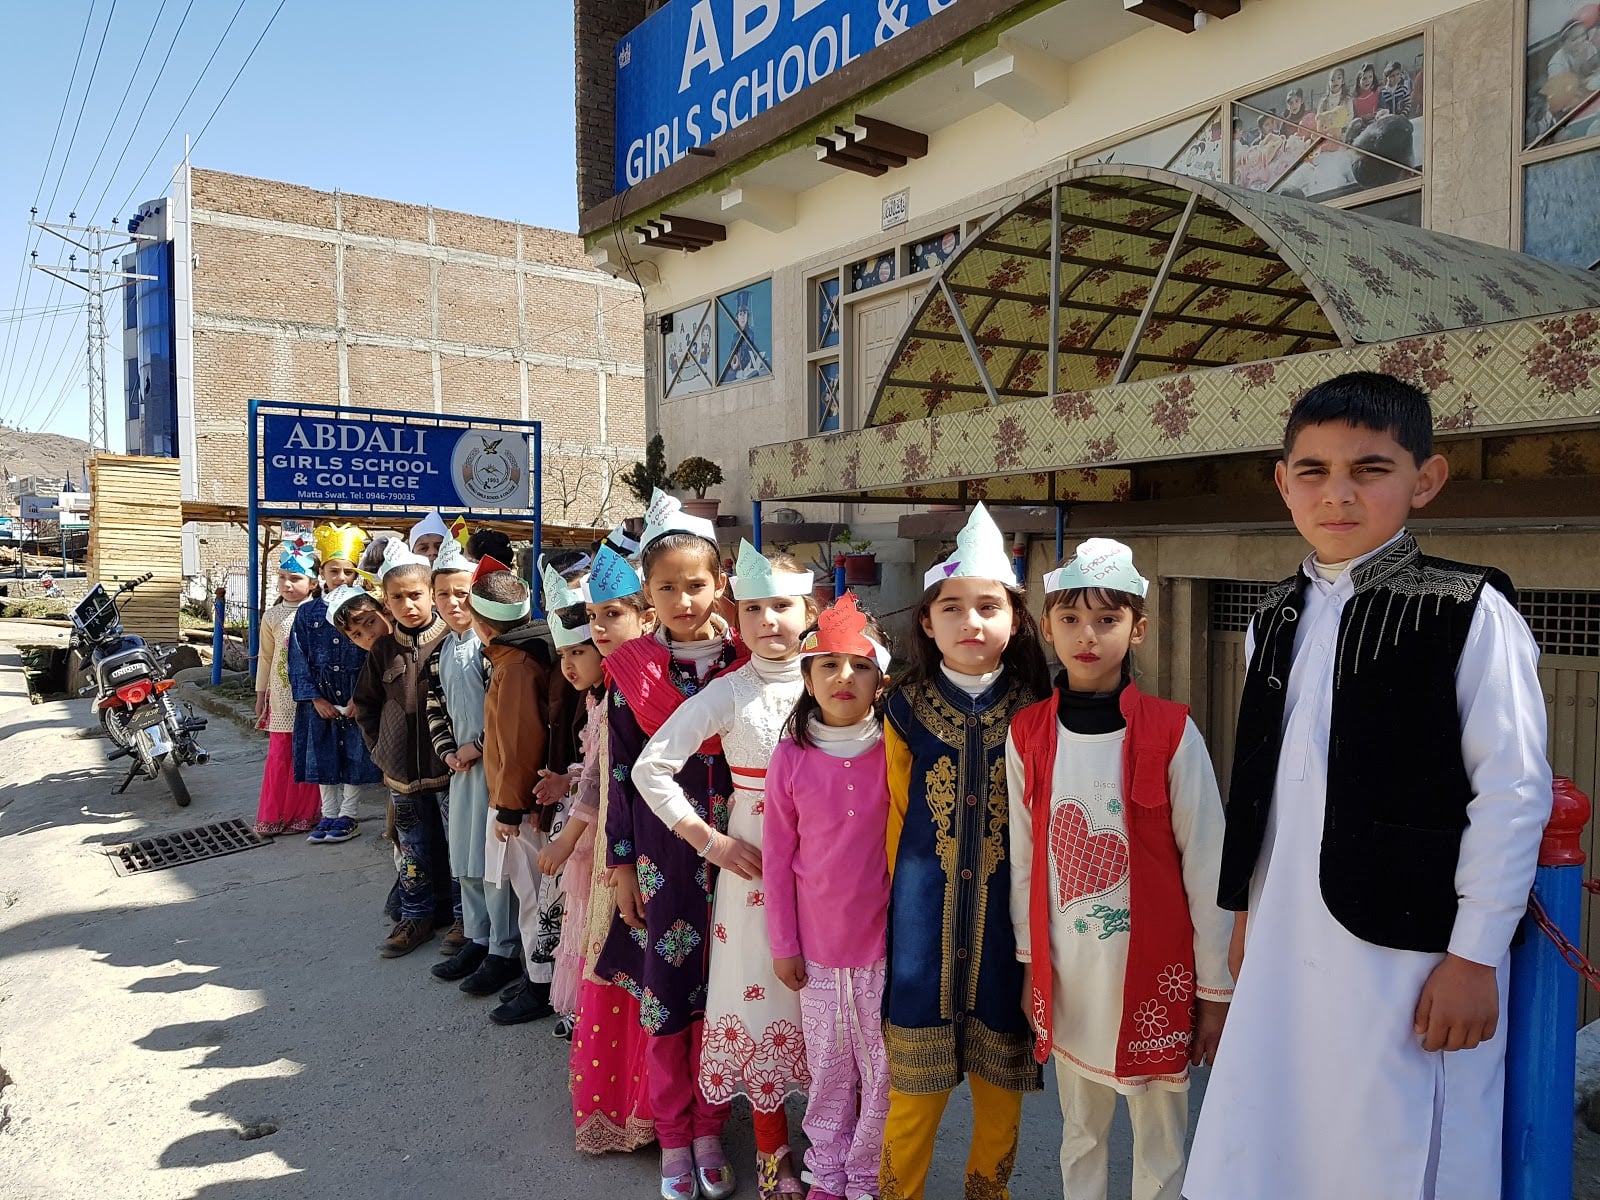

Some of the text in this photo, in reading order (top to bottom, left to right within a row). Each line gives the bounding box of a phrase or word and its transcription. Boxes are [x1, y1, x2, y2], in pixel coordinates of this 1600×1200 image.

[678, 0, 827, 94] AB
[625, 104, 702, 187] GIRLS
[711, 13, 861, 141] SCHOOL
[283, 422, 428, 455] ABDALI
[271, 454, 439, 475] GIRLS SCHOOL
[293, 472, 420, 489] & COLLEGE
[297, 490, 416, 501] Matta Swat. Tel: 0946-790035
[591, 553, 608, 581] HAPPY
[599, 554, 622, 591] SPRING
[1094, 561, 1121, 581] DAY
[1093, 780, 1116, 790] Disco
